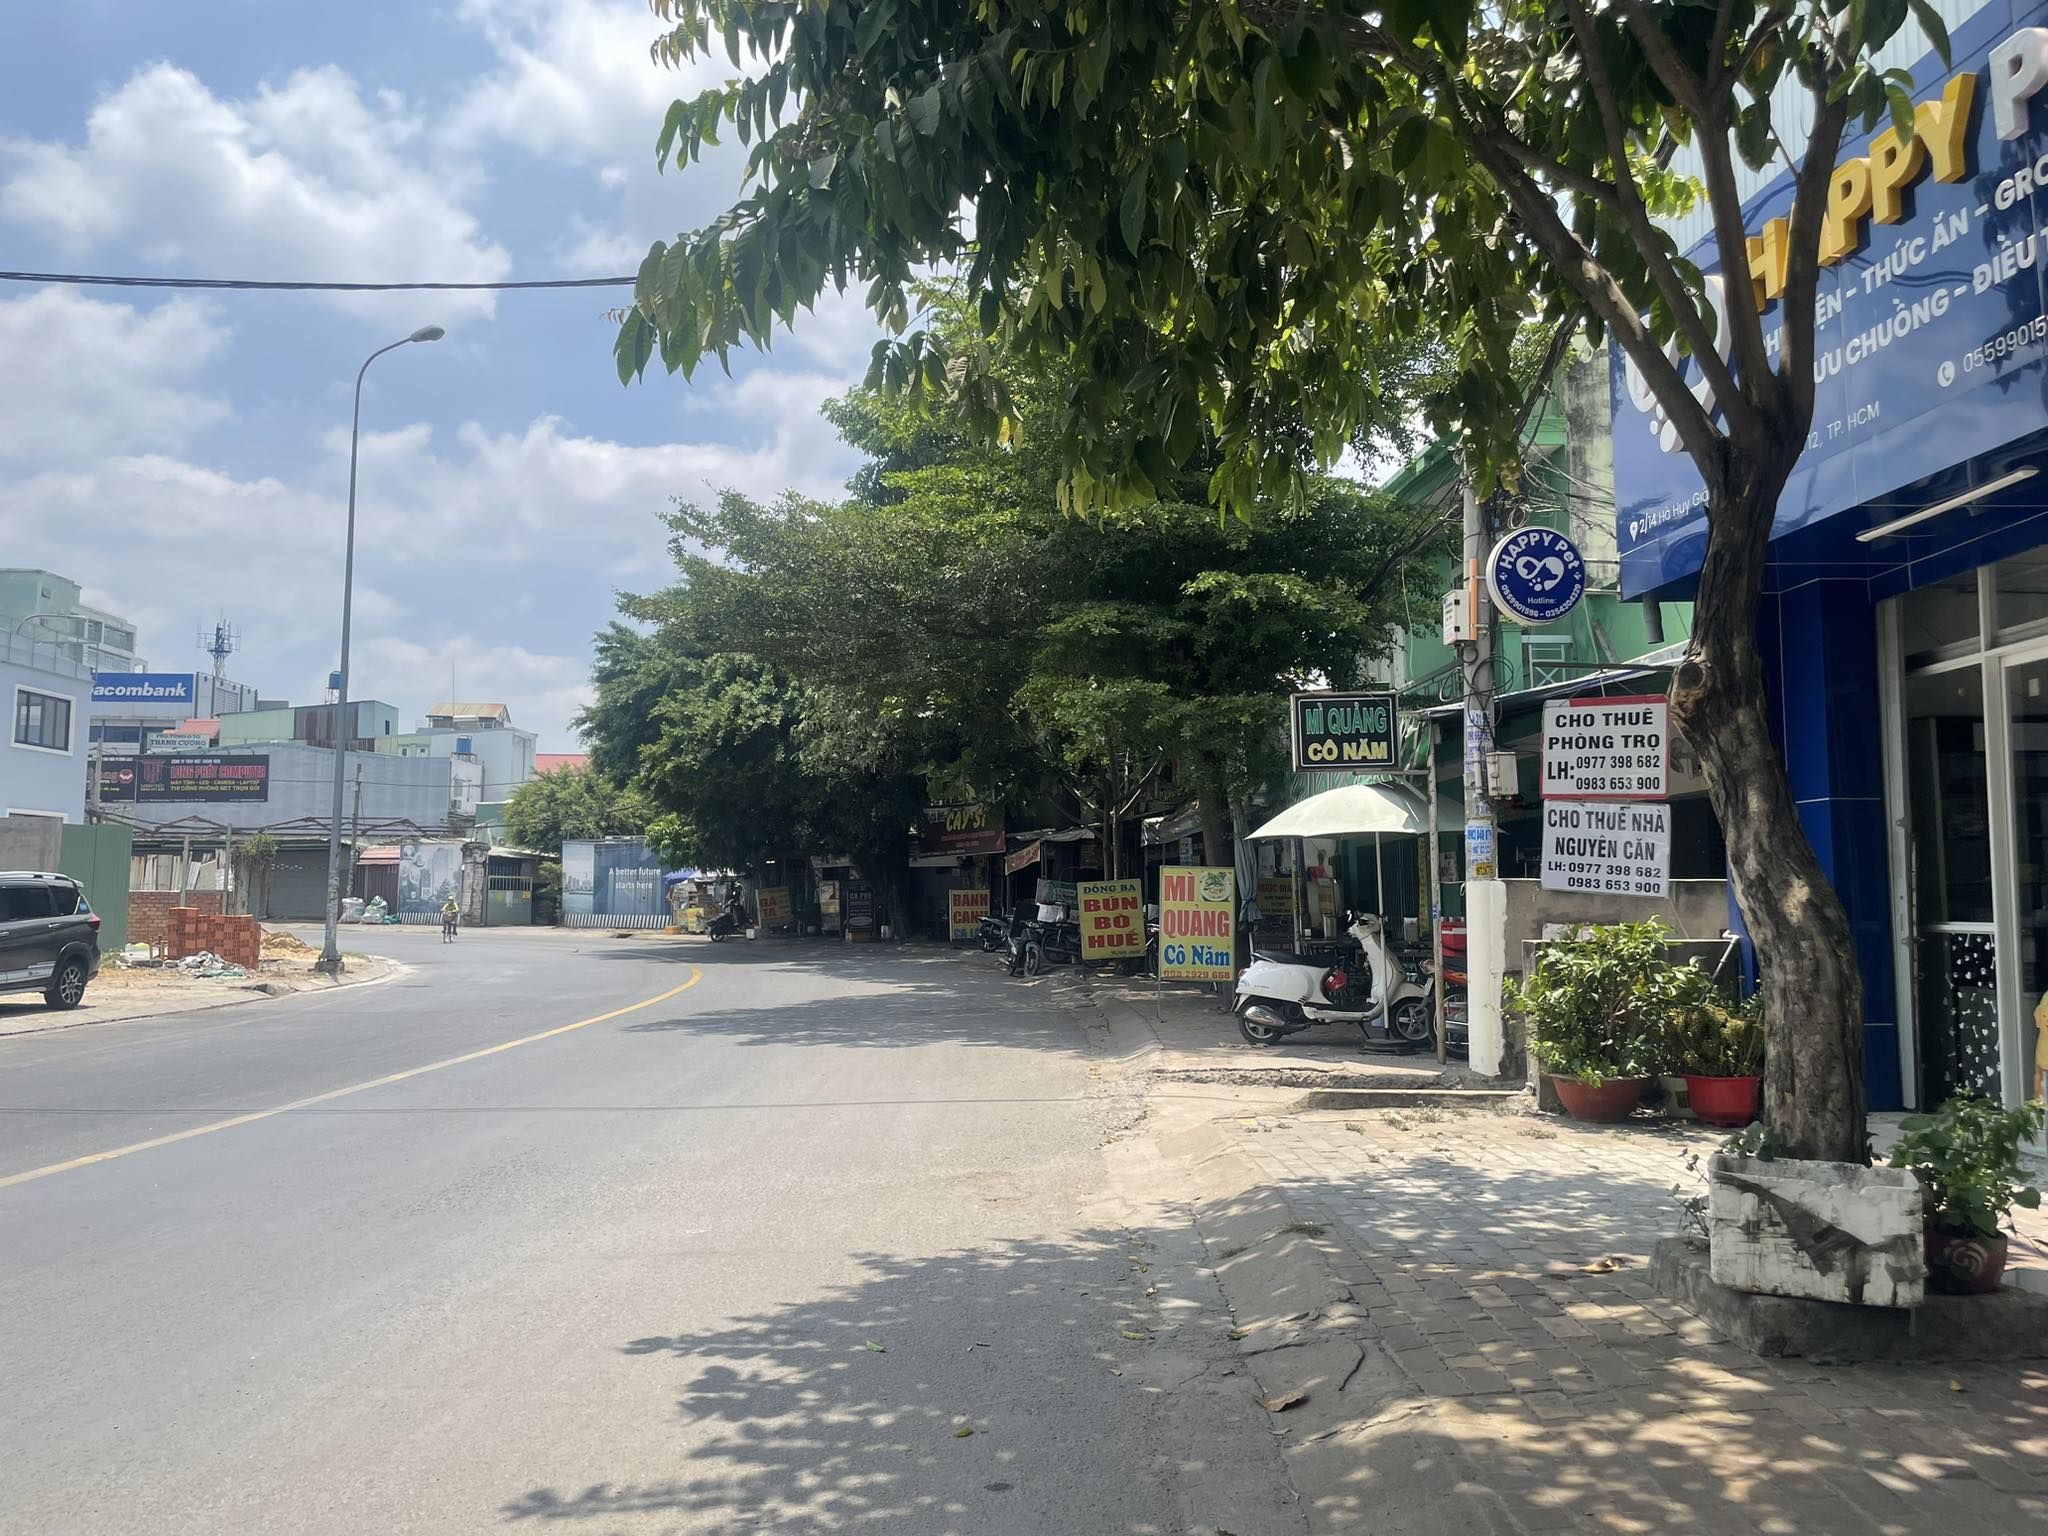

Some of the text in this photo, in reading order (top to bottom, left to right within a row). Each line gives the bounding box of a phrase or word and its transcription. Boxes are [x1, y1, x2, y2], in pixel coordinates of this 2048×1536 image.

[1745, 72, 1978, 313] HPPY
[1861, 238, 1928, 294] THỨC
[1931, 211, 1969, 254] ĂN
[1814, 346, 1842, 384] ƯU
[1846, 288, 1950, 365] CHUỒNG
[1972, 234, 2036, 295] ĐIỀU
[1962, 314, 2048, 373] 05599015
[1639, 512, 1657, 534] 2/14
[1658, 506, 1671, 524] Hà
[1673, 499, 1690, 517] Huy
[1847, 401, 1880, 431] HCM
[1500, 533, 1580, 569] HAPPY Pet
[91, 682, 187, 697] acombank
[1305, 701, 1387, 736] MÌ QUẢNG
[1555, 708, 1654, 728] CHO THUÊ
[1308, 738, 1388, 761] CÔ NĂM
[1548, 733, 1660, 751] PHÒNG TRỌ
[1547, 755, 1660, 780] LH: 0977 398 682
[1576, 777, 1660, 790] 0983 653 900
[1547, 809, 1580, 828] CHO
[1632, 810, 1664, 833] NHÀ
[1555, 835, 1655, 861] NGUYÊN CĂN
[608, 867, 661, 876] A better future
[1548, 861, 1661, 878] LH: 0977 398 682
[636, 881, 653, 889] here
[1164, 872, 1196, 902] MÌ
[1567, 877, 1661, 893] 0983 653 900
[1083, 895, 1138, 913] BÚN
[1094, 913, 1130, 930] BÒ
[1163, 904, 1230, 938] QUẢNG
[1088, 928, 1139, 948] HUẾ
[1164, 943, 1230, 967] Cô Năm
